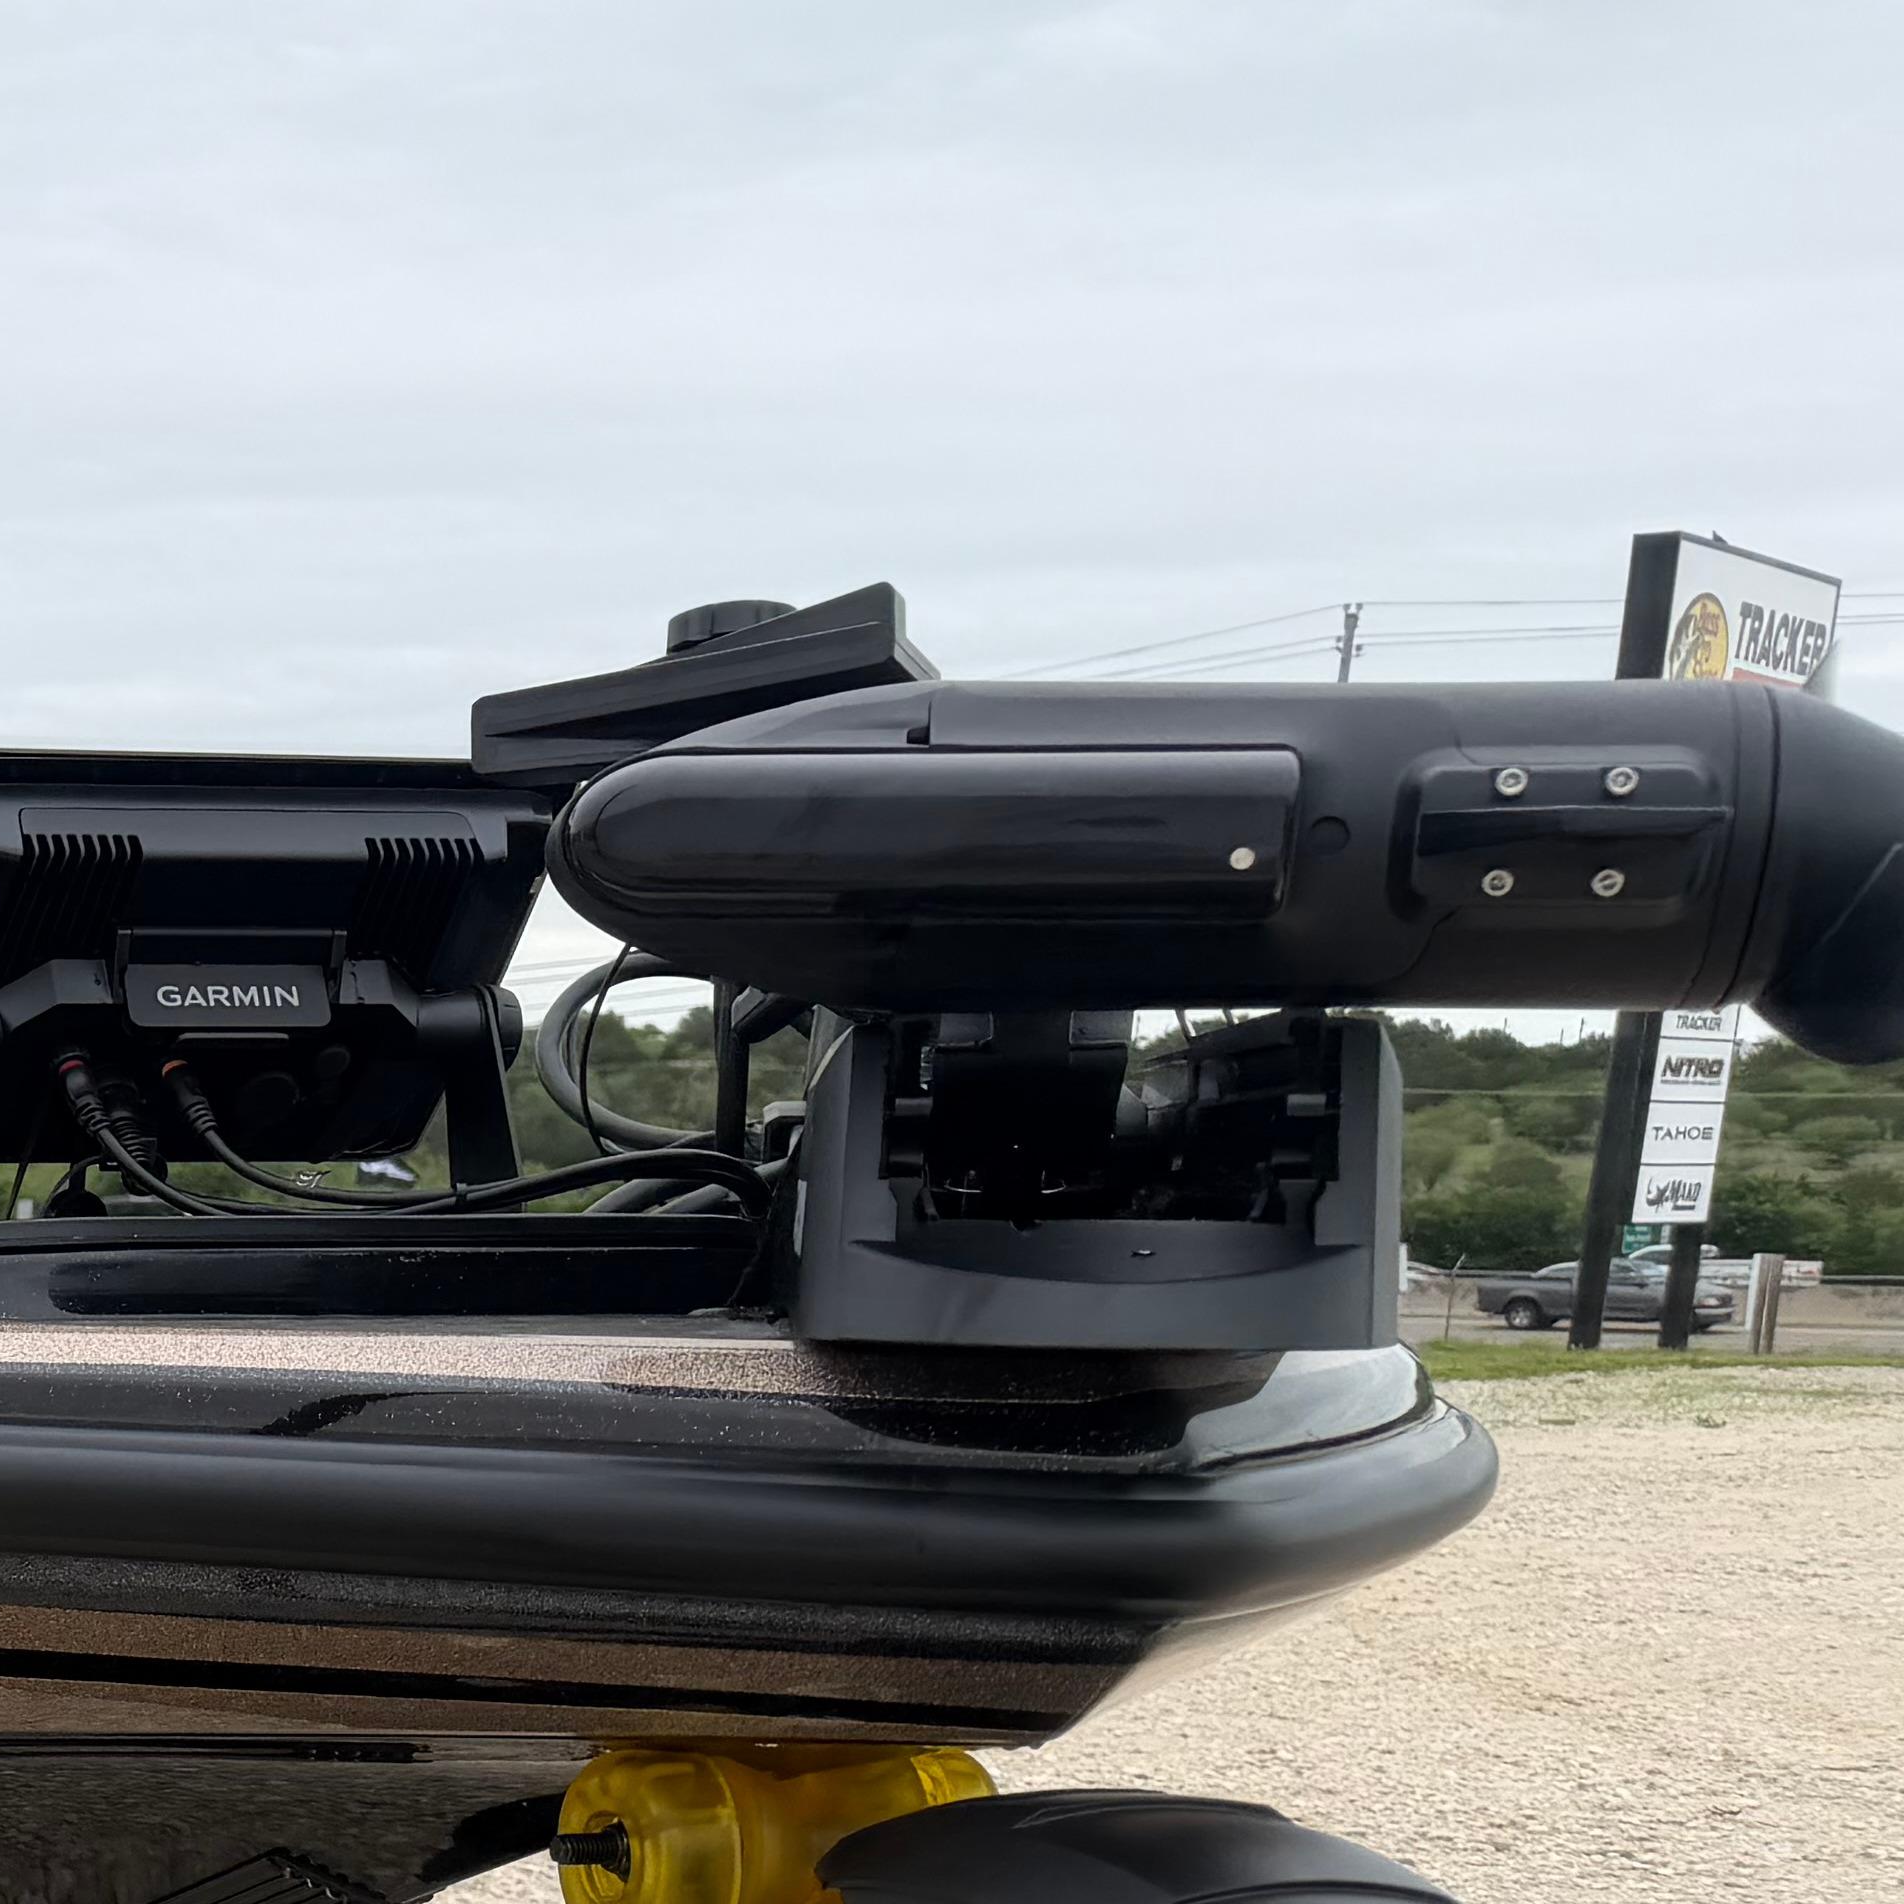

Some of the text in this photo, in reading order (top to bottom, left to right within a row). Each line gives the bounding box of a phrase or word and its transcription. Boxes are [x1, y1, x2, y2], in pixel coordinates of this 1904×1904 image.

[1734, 601, 1827, 676] TRACKER
[156, 985, 299, 1007] GARMIN
[1676, 1014, 1722, 1031] TRACKER
[1661, 1055, 1724, 1078] NITRO
[1652, 1126, 1713, 1141] TAHOE
